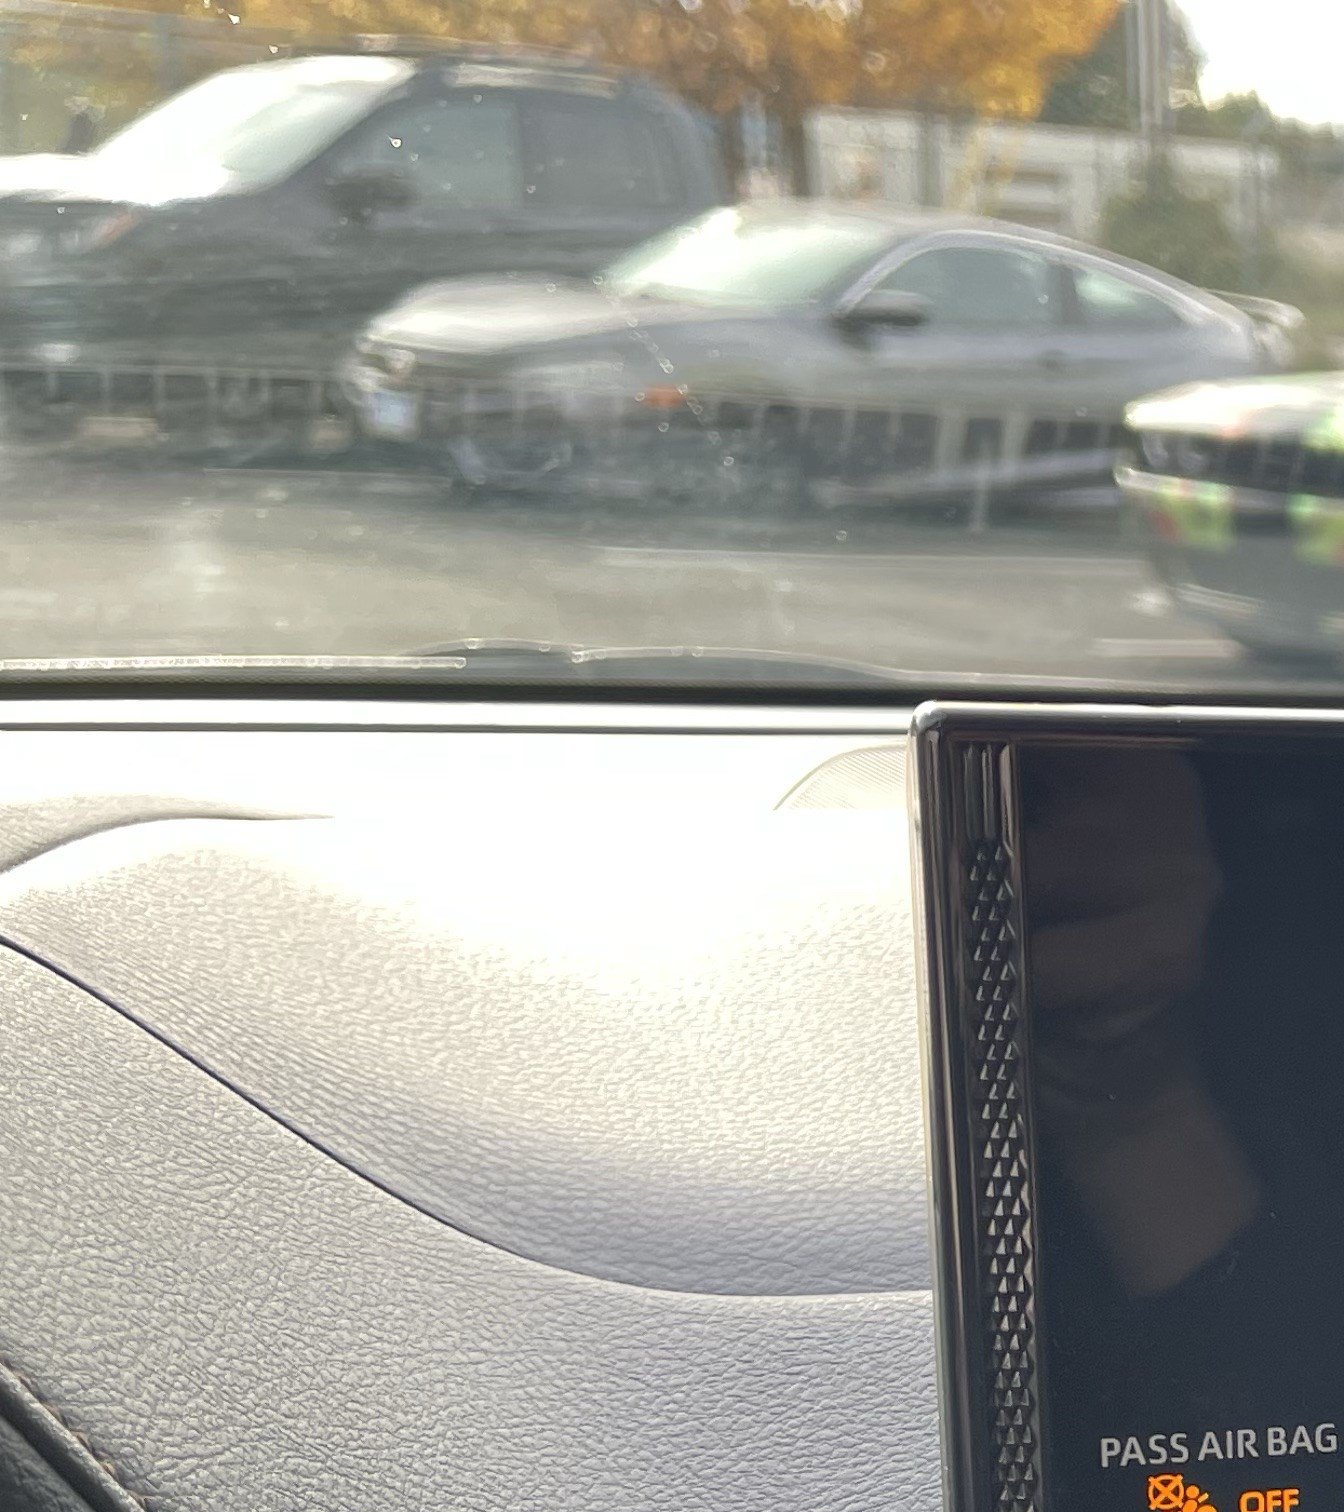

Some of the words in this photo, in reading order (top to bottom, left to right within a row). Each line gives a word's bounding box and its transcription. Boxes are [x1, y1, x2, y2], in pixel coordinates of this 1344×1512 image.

[1100, 1433, 1189, 1468] PASS
[1198, 1429, 1259, 1461] AIR
[1267, 1423, 1338, 1456] BAG
